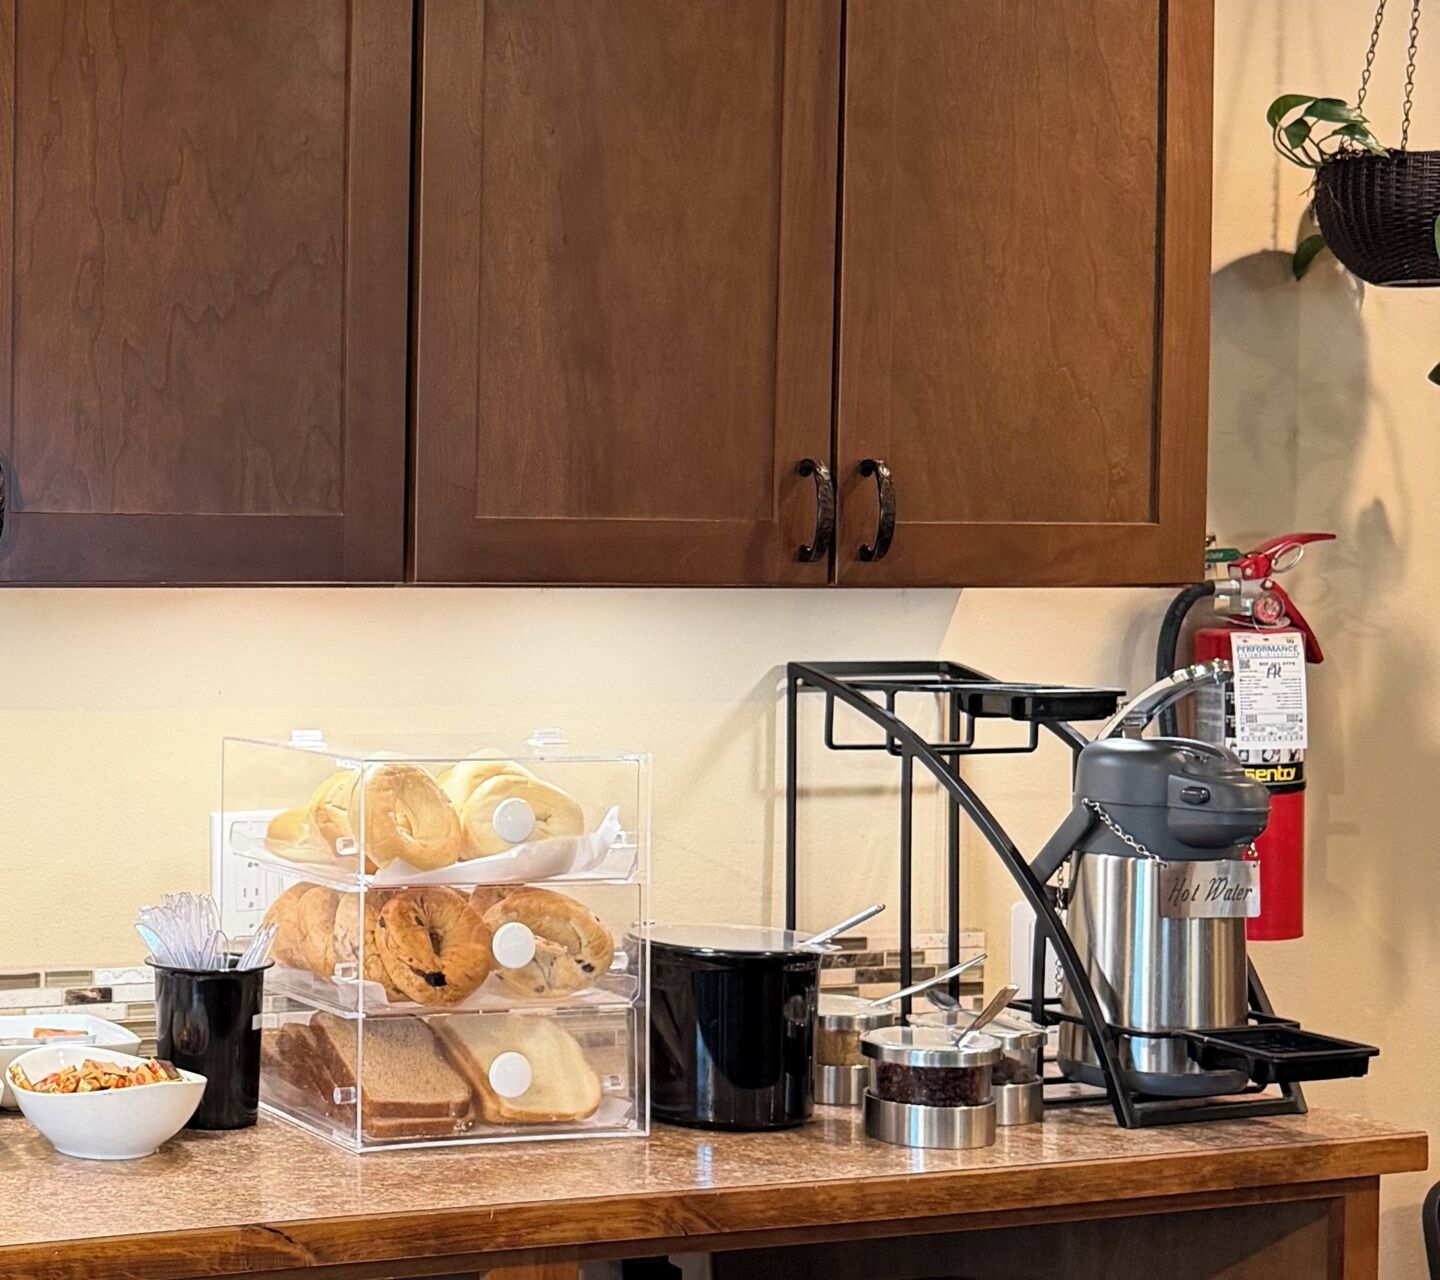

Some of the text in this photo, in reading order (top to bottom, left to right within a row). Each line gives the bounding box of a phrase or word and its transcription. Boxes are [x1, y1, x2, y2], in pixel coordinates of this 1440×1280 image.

[1237, 644, 1298, 653] PERFORMANCE
[1168, 877, 1253, 907] Hot Water
